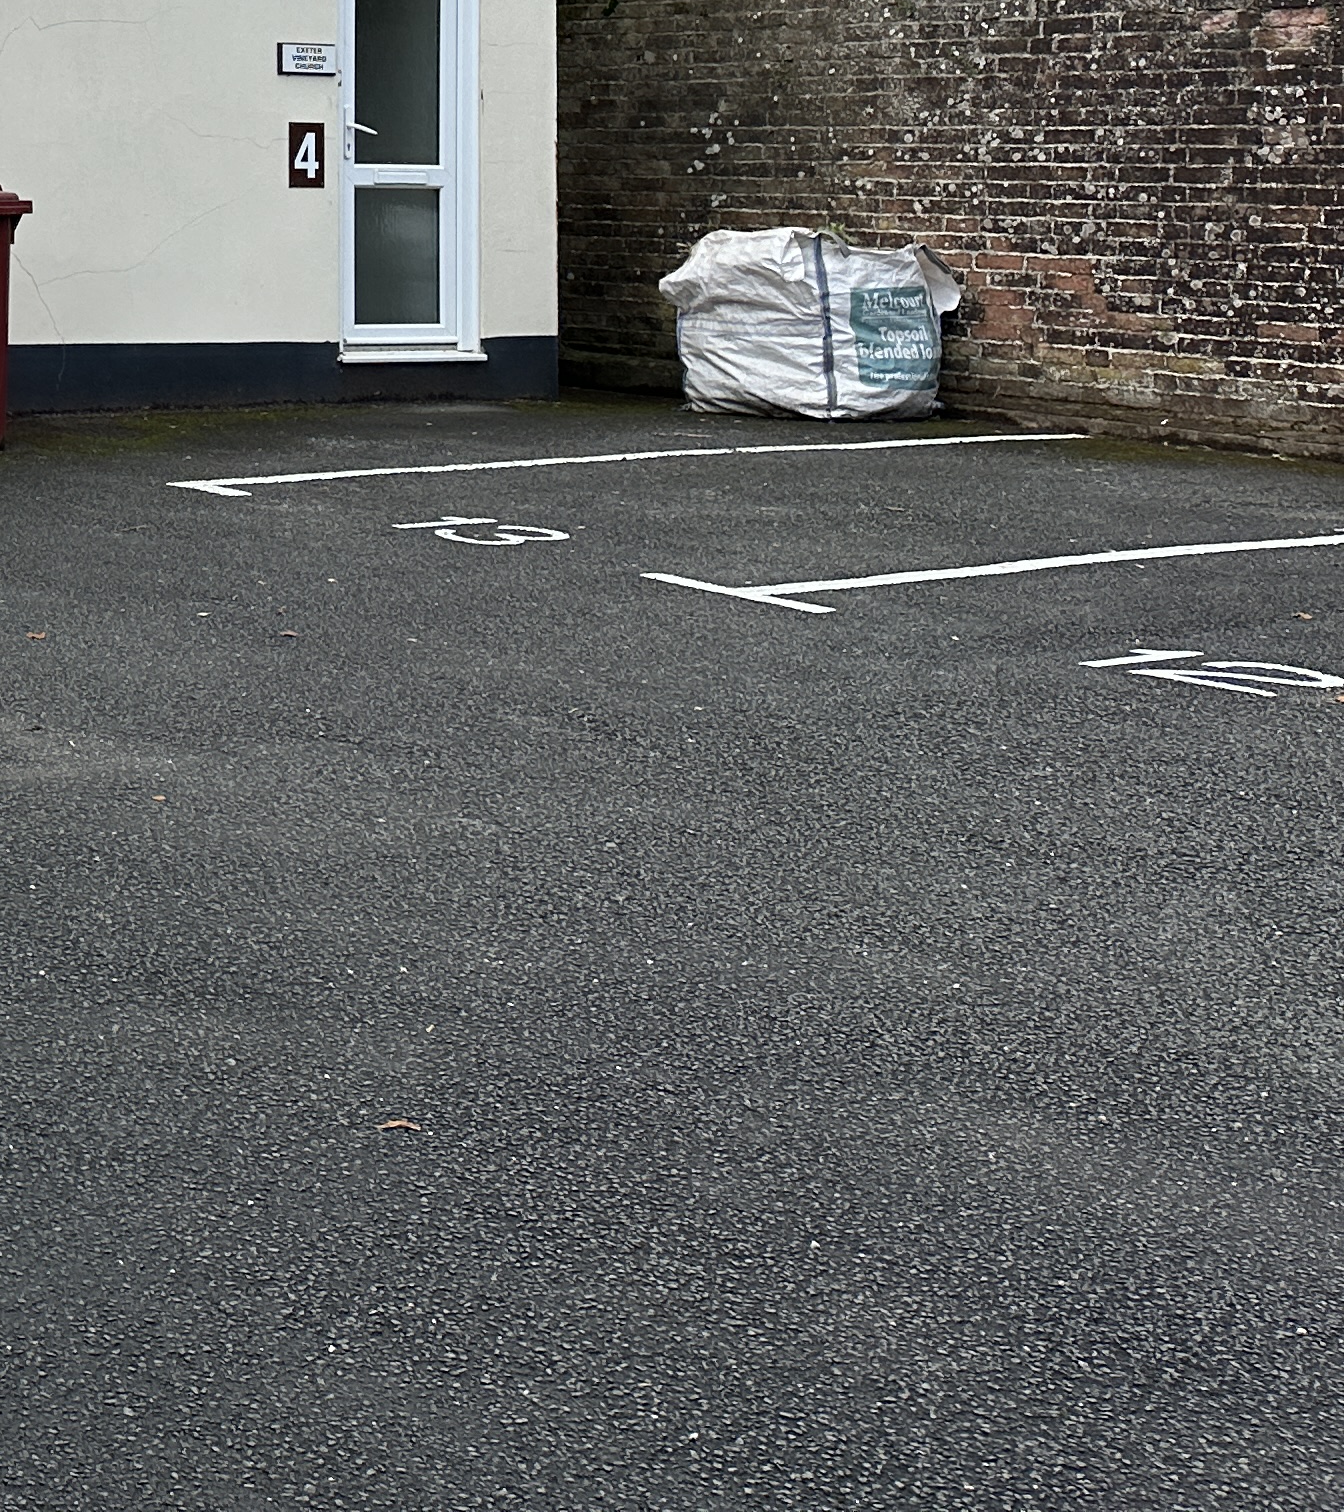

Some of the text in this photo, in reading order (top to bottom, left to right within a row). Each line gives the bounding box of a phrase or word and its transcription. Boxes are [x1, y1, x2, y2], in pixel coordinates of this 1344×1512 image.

[294, 131, 320, 179] 4
[862, 291, 924, 309] Melcourt
[878, 324, 929, 346] Topsoil
[858, 341, 920, 360] blended
[392, 516, 570, 546] 13
